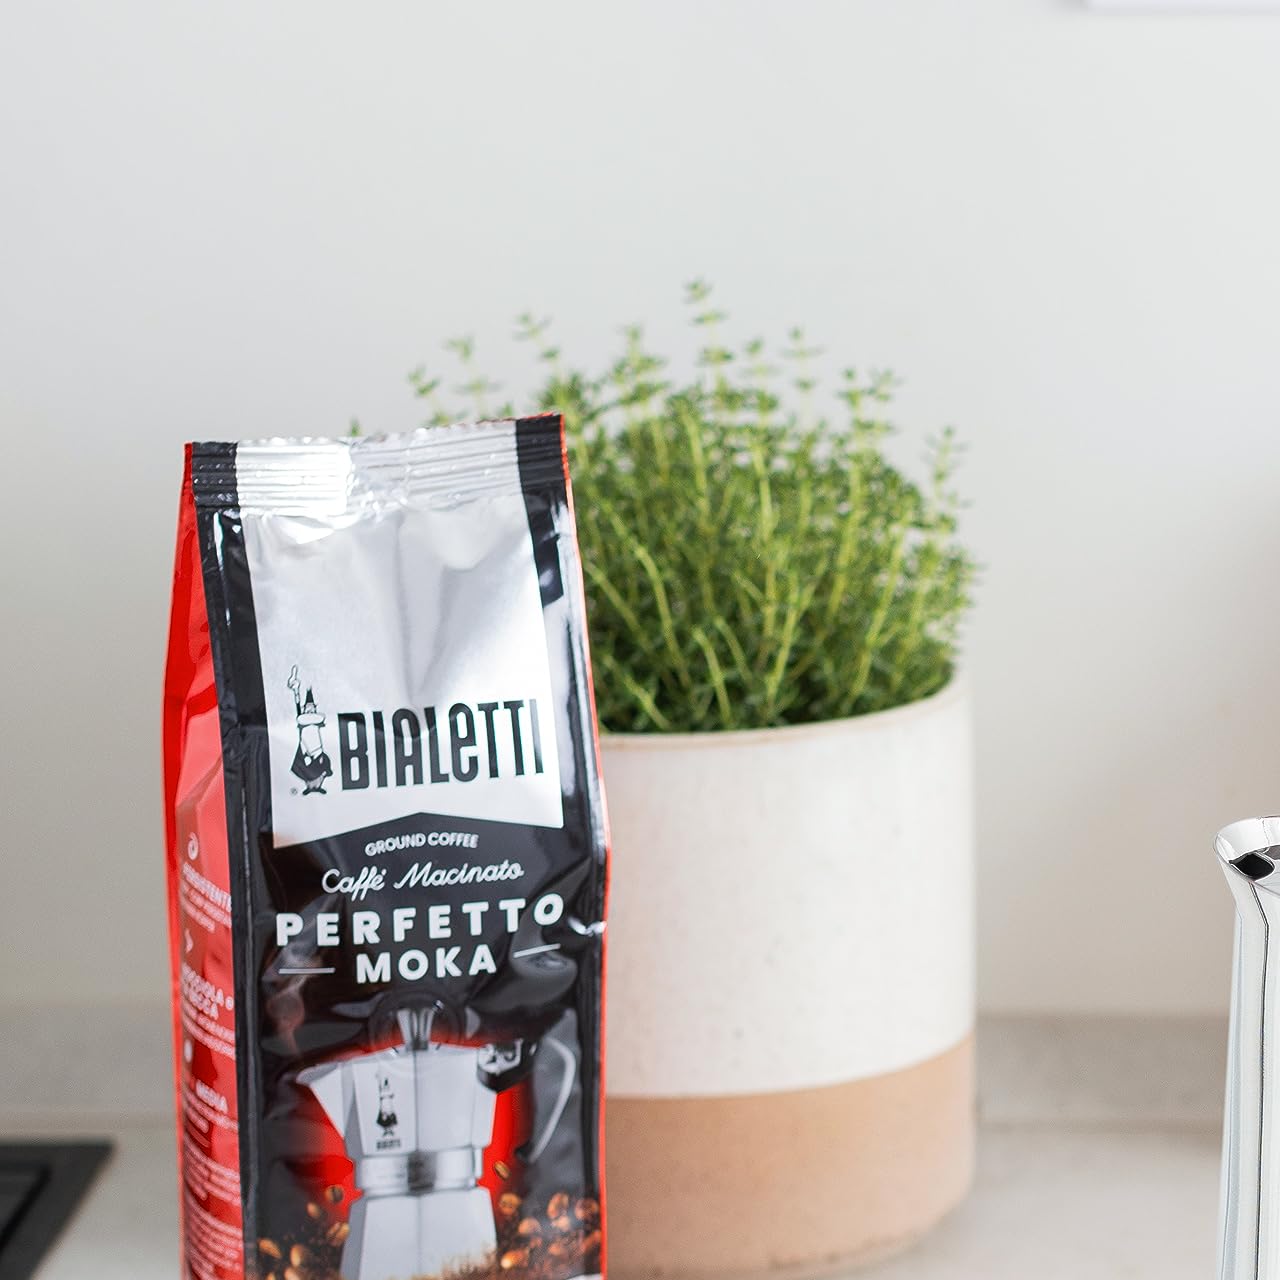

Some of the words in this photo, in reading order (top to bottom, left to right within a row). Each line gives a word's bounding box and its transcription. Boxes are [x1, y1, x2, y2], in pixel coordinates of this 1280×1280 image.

[364, 833, 426, 857] GROUND
[428, 832, 479, 849] COFFEE
[394, 859, 525, 889] Macinato
[275, 893, 565, 947] PERFETTO
[356, 943, 498, 984] MOKA
